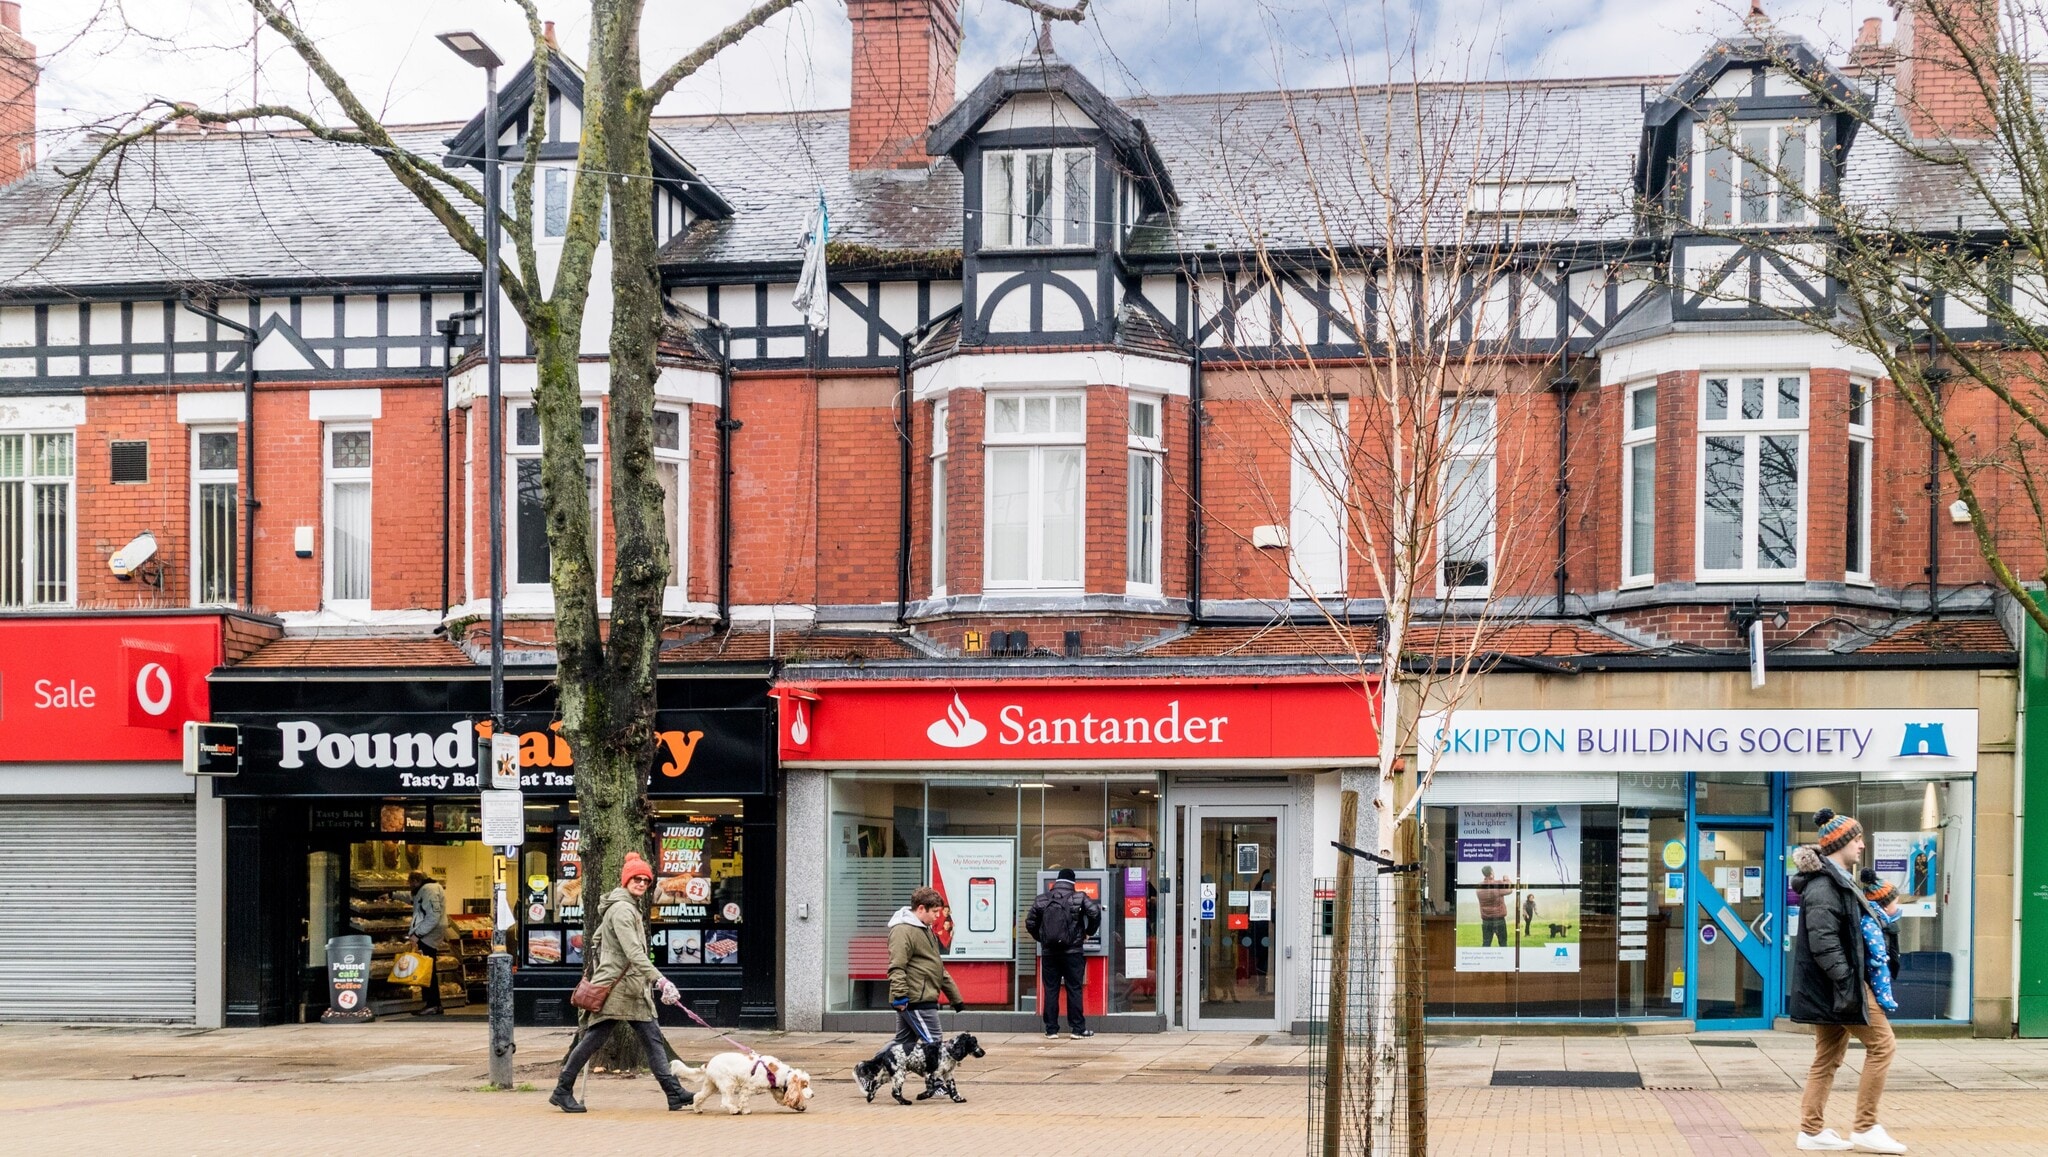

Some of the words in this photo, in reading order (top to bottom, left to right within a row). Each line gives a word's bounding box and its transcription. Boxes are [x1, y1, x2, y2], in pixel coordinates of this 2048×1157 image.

[966, 633, 981, 650] H
[34, 679, 96, 709] Sale
[999, 700, 1228, 744] Santander
[1436, 727, 1565, 754] SKIPTON
[1577, 727, 1729, 754] BUILDING
[1738, 727, 1873, 760] SOCIETY
[399, 772, 449, 790] Tasty
[520, 772, 539, 786] at
[542, 772, 576, 786] Tas
[1464, 810, 1483, 818] What
[1477, 819, 1507, 828] brighter
[662, 826, 705, 838] JUMBO
[1463, 827, 1491, 835] outlook
[661, 838, 706, 850] VEGAN
[663, 850, 703, 861] STEAK
[953, 858, 962, 866] My
[963, 858, 981, 866] Money
[982, 858, 1007, 866] Manager
[662, 862, 703, 874] PASTY
[689, 885, 703, 896] £1
[531, 906, 544, 916] £1
[659, 903, 707, 917] LAVAZZA
[726, 905, 737, 915] £1
[332, 962, 365, 971] Pound
[338, 969, 359, 978] café
[340, 993, 354, 1005] £1
